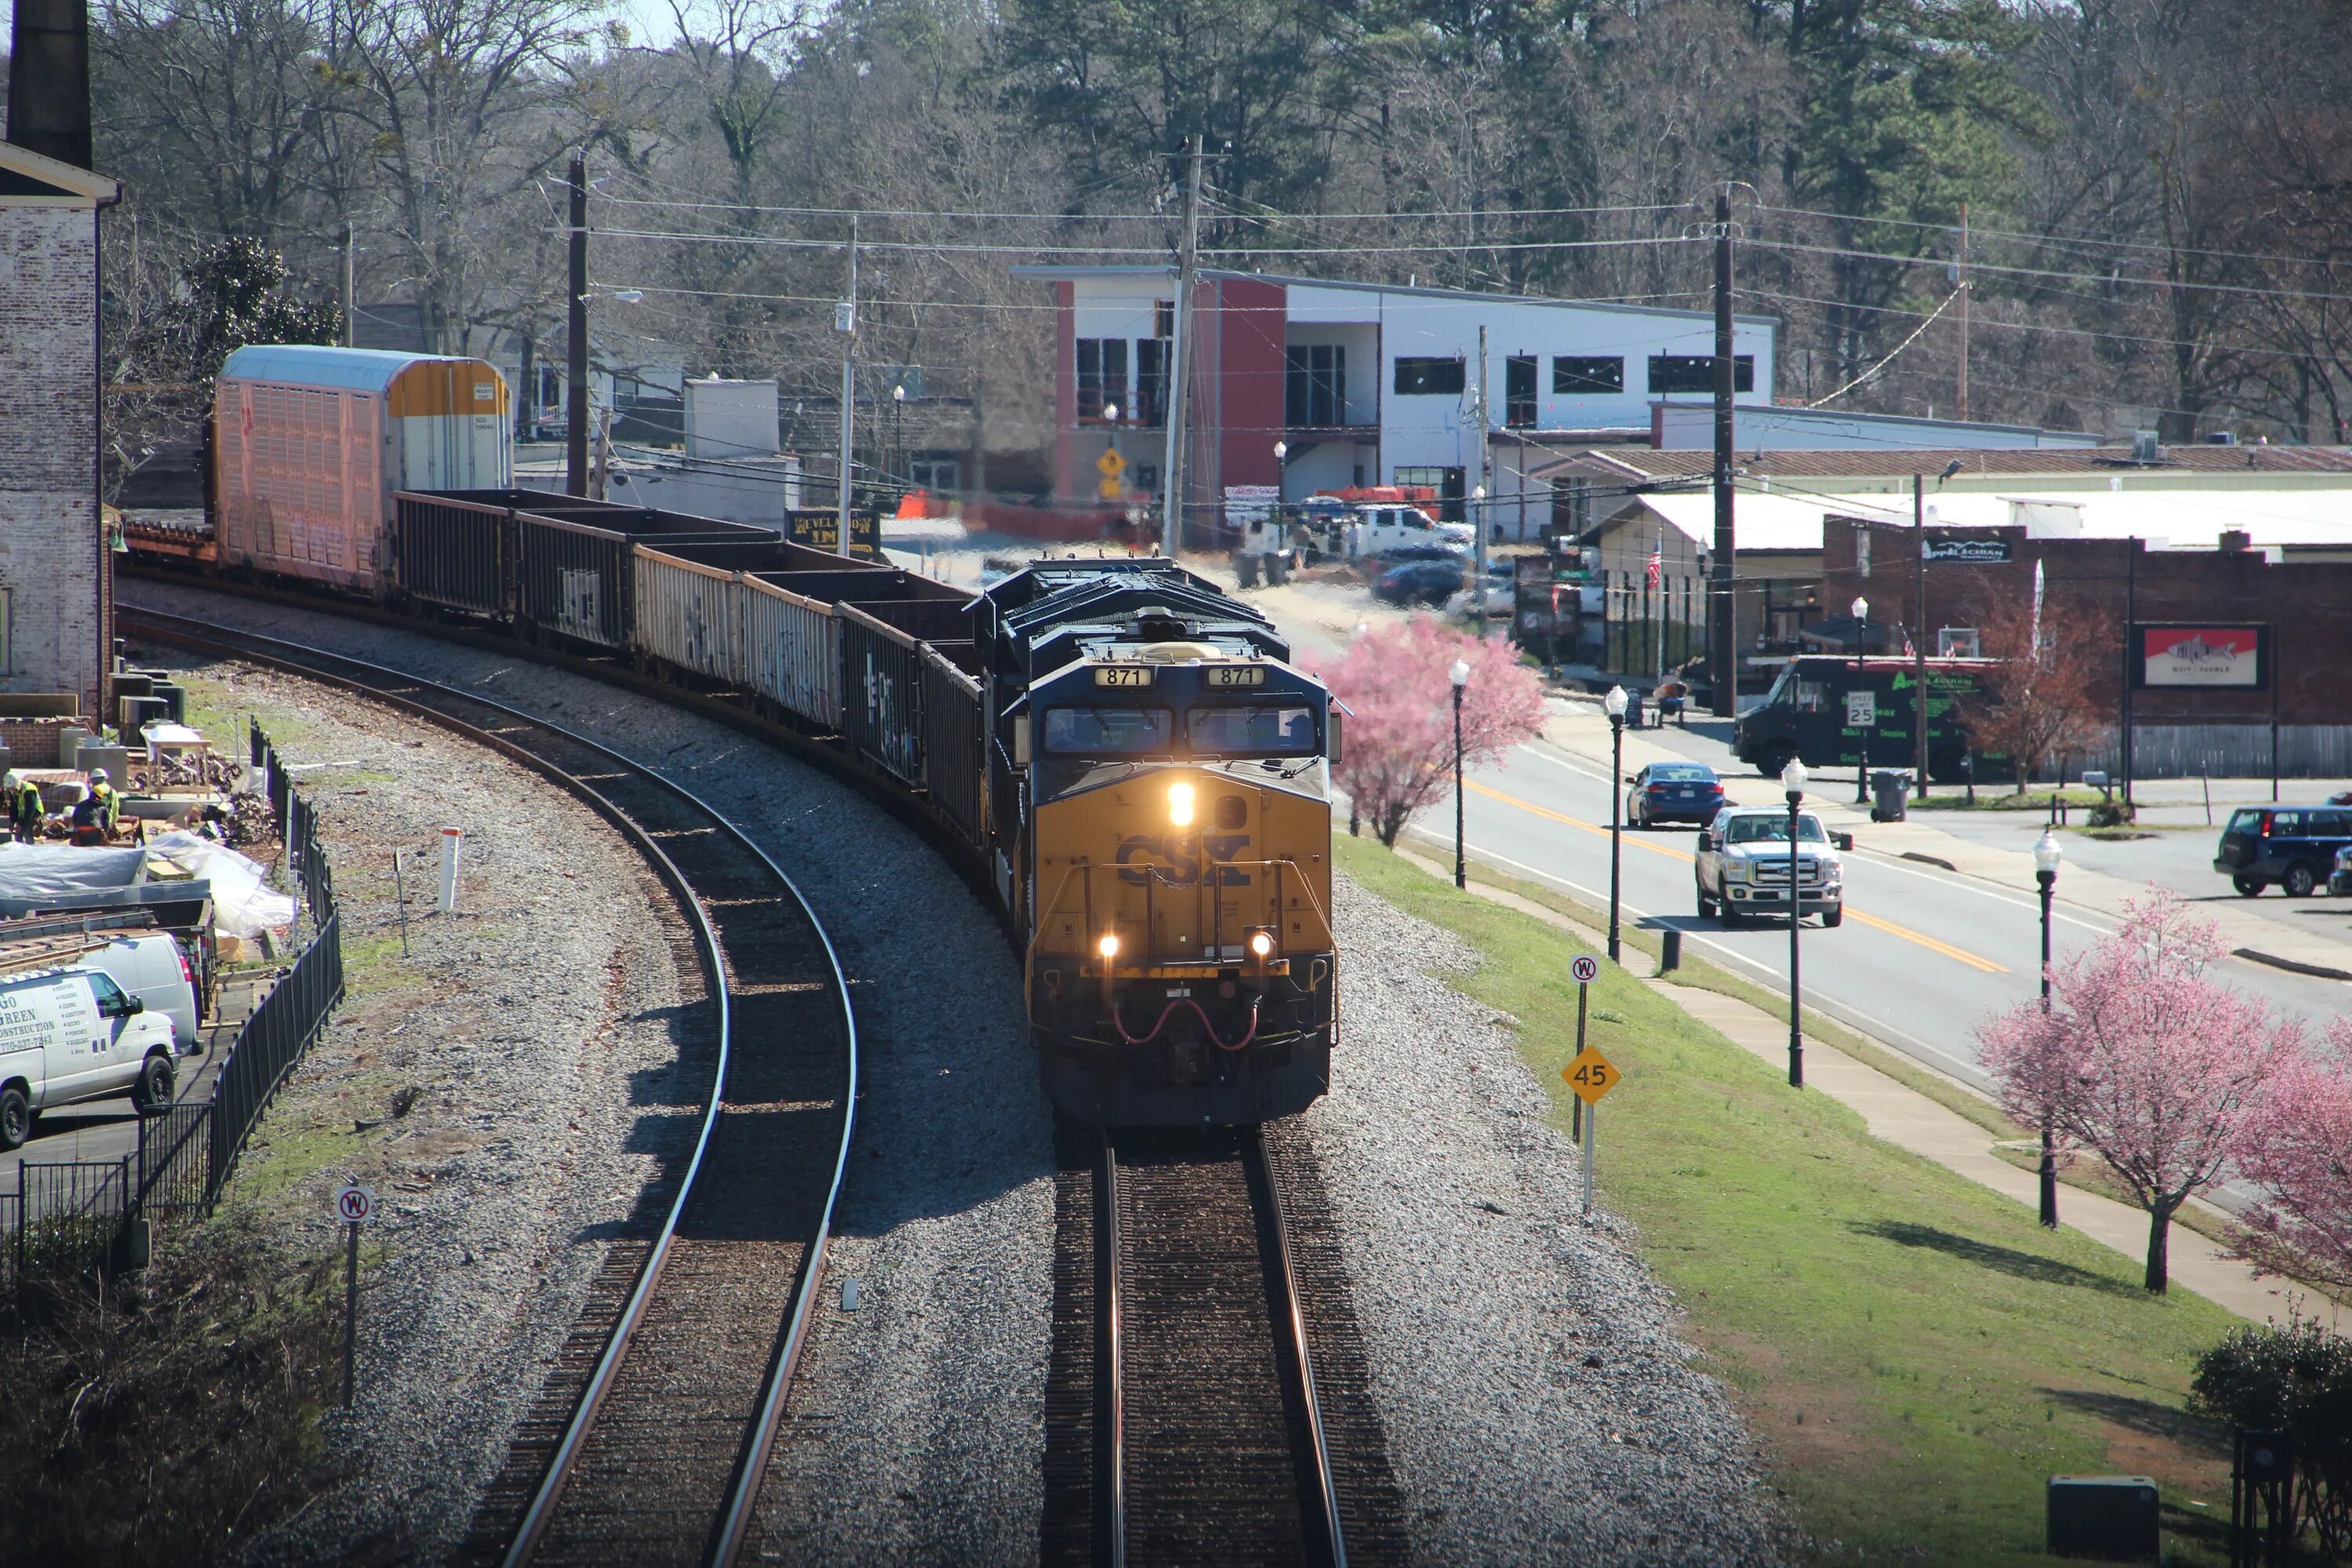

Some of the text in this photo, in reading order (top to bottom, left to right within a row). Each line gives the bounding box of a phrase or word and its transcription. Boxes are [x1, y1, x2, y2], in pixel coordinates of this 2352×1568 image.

[794, 517, 872, 534] REVELAON
[1107, 669, 1140, 685] 871
[1221, 668, 1253, 684] 871
[1850, 710, 1872, 721] 25
[1116, 835, 1250, 887] CSX
[1578, 962, 1591, 976] W
[1, 1034, 53, 1051] 770-337-7243
[1573, 1065, 1606, 1086] 45
[347, 1196, 361, 1213] W
